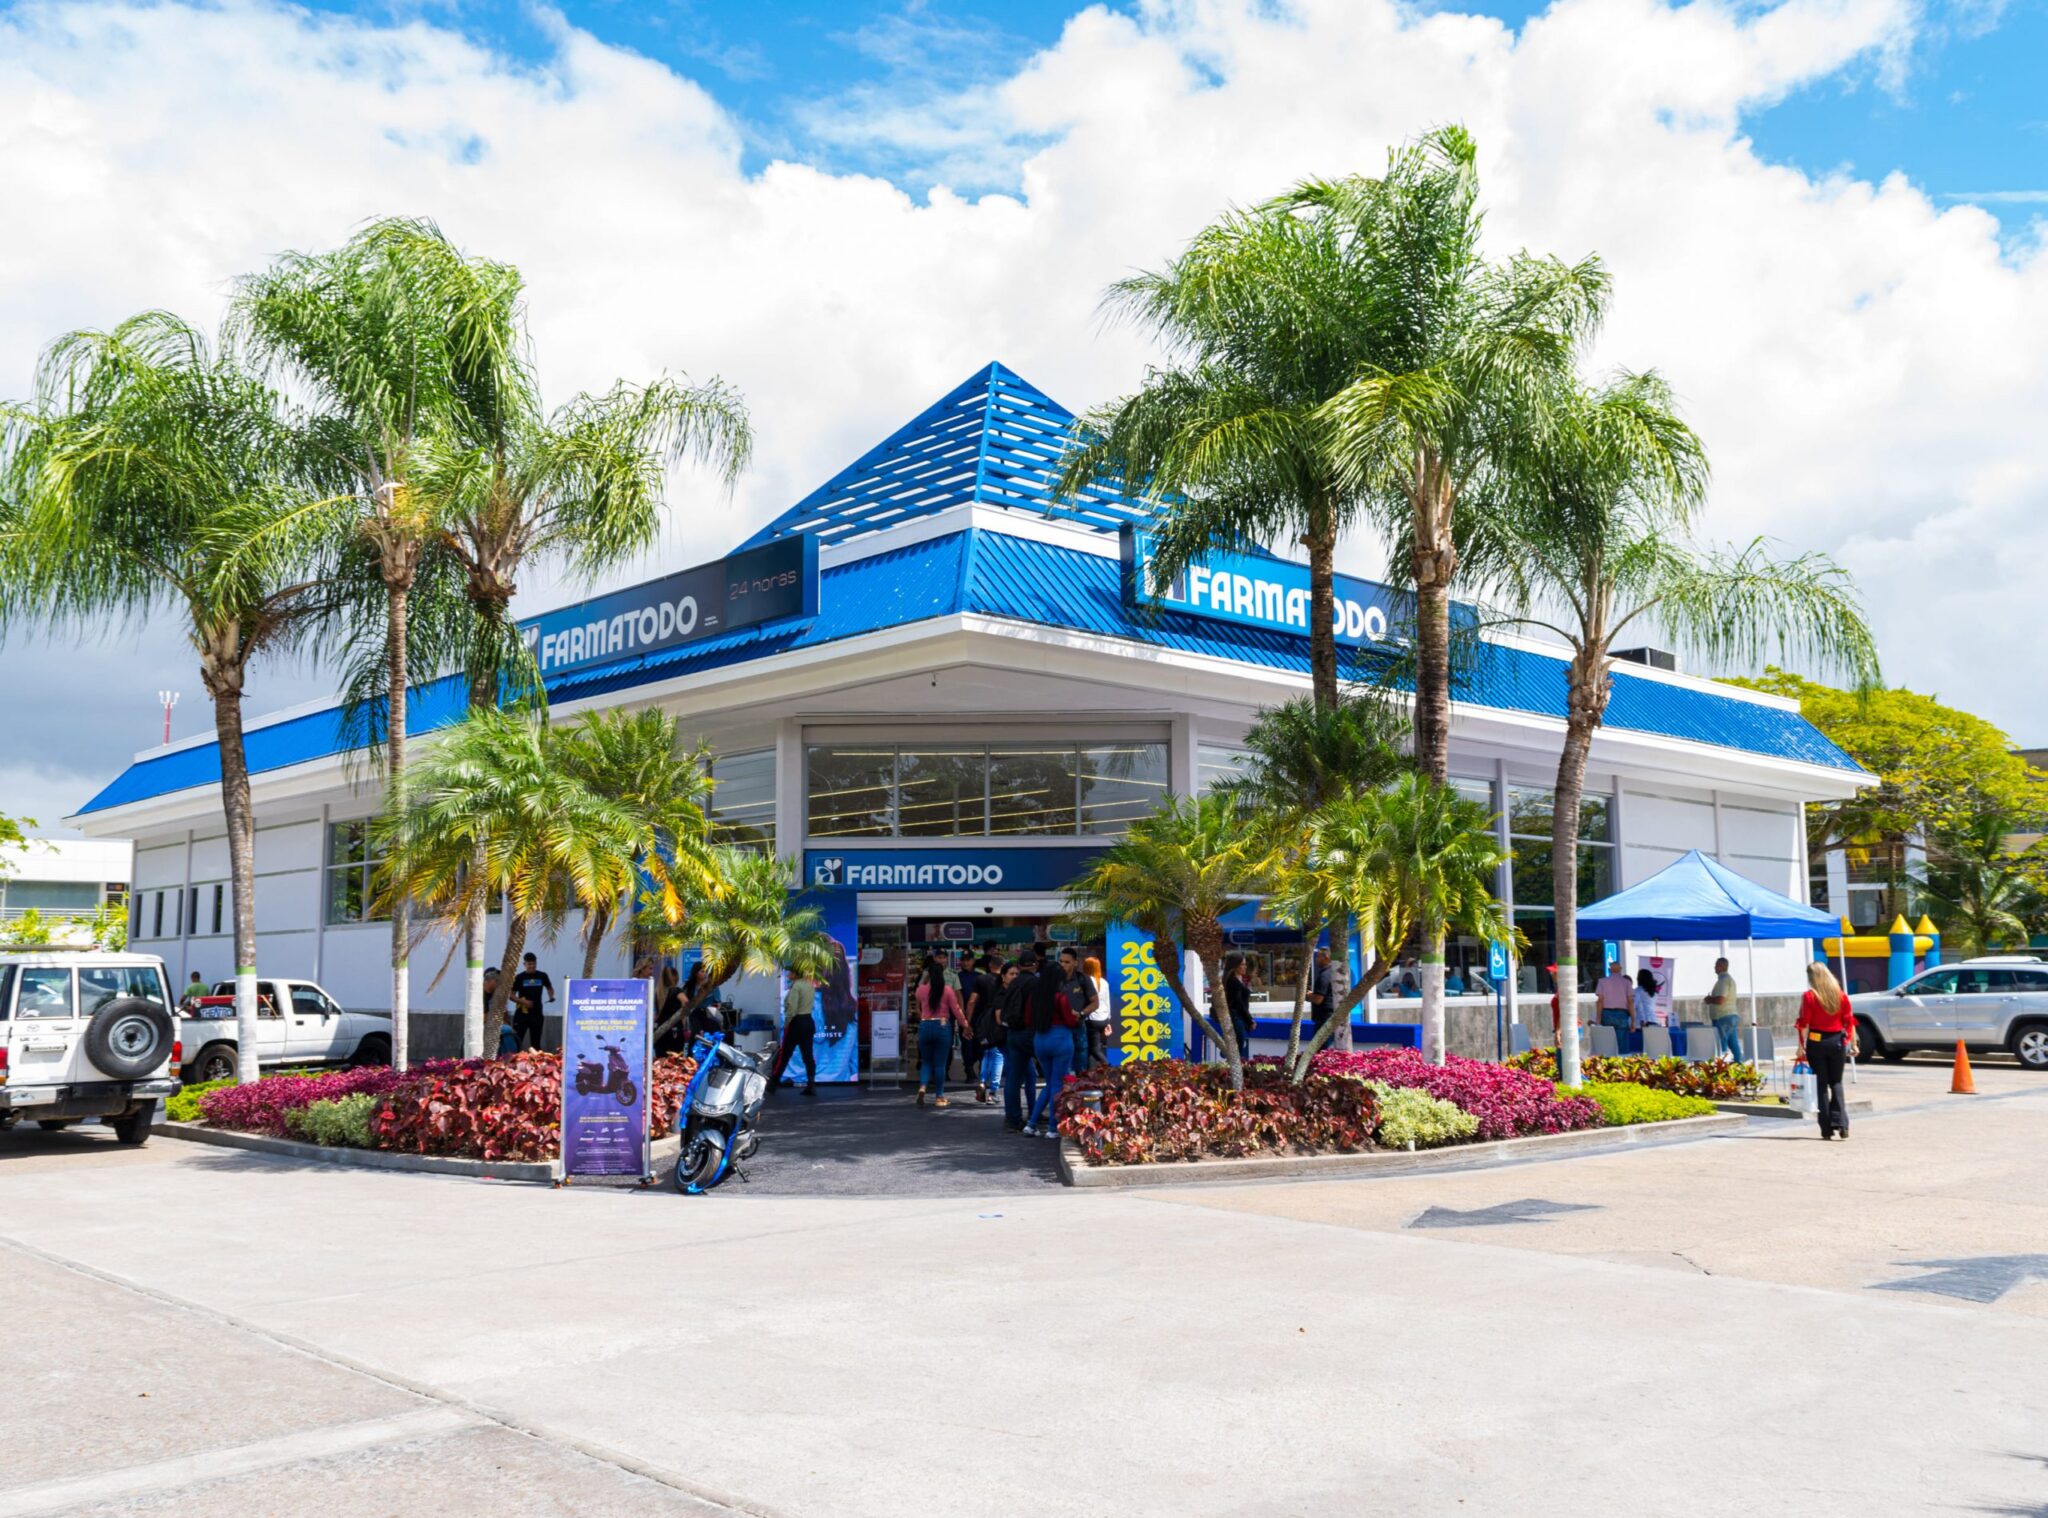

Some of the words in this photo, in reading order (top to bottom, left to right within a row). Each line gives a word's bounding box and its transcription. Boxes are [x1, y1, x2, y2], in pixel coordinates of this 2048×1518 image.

[729, 581, 748, 600] 24
[752, 570, 797, 592] horas
[1191, 565, 1387, 641] FARMAODO
[541, 595, 698, 670] FARMATODO
[847, 864, 1003, 885] FARMATODO
[1120, 992, 1171, 1017] 20%
[1120, 1018, 1171, 1043] 20%
